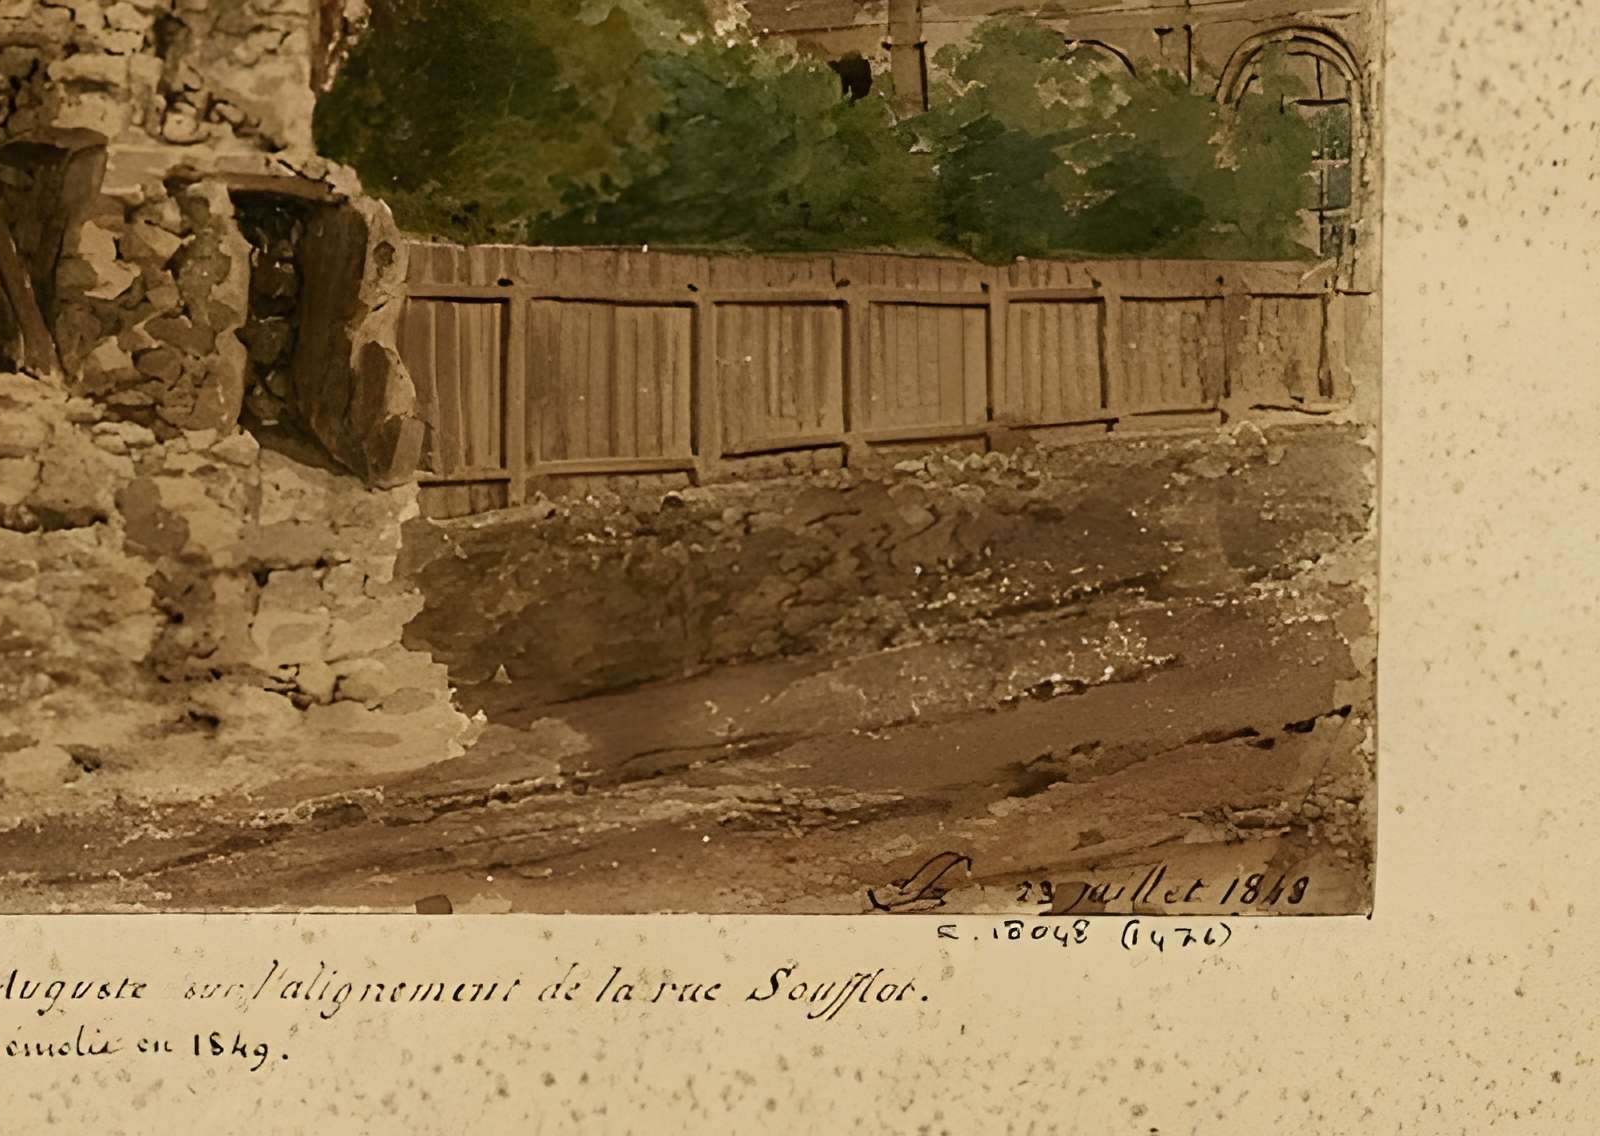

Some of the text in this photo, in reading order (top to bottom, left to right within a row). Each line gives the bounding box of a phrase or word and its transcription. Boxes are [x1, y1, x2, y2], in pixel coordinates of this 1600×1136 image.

[1061, 862, 1210, 914] juillet
[251, 959, 521, 1020] l'alignement
[538, 962, 582, 1002] de
[595, 966, 634, 1003] la
[650, 978, 722, 1002] rue
[745, 966, 931, 1020] Soufflot.
[136, 1037, 174, 1053] en
